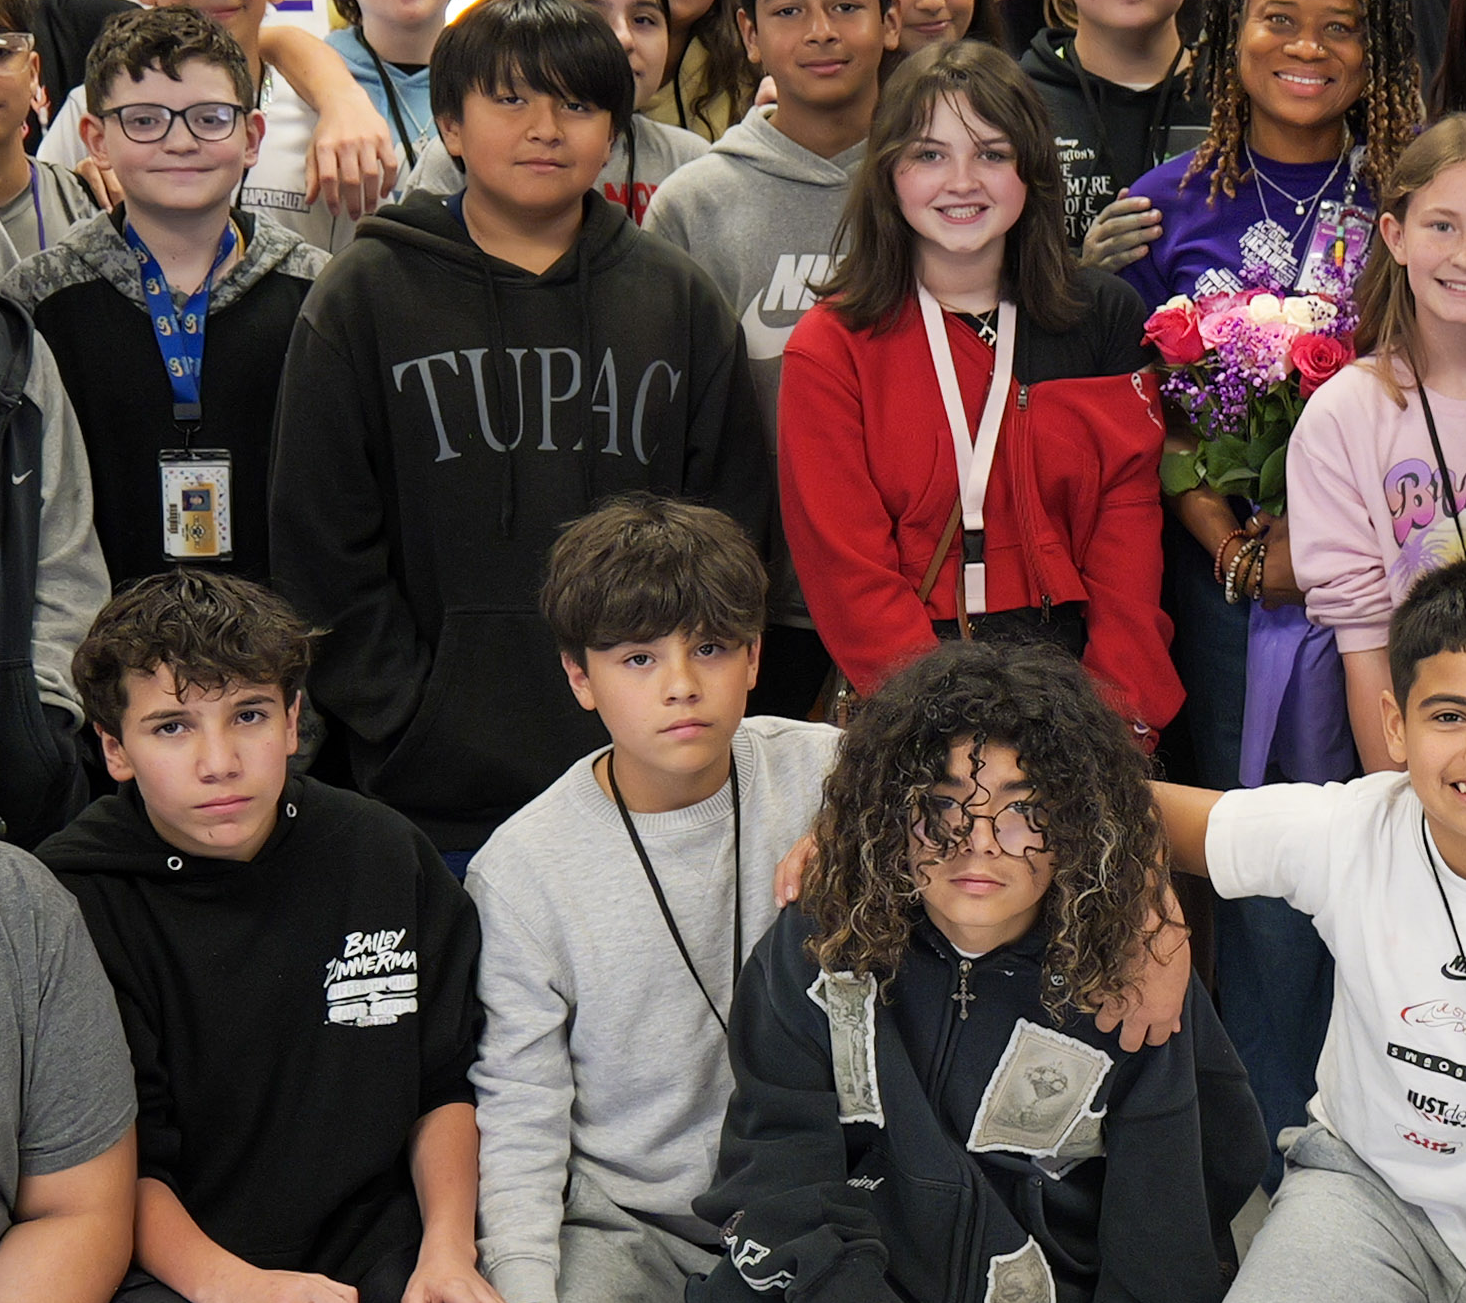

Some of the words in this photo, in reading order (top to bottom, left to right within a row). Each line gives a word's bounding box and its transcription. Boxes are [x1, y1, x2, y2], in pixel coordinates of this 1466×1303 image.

[392, 347, 683, 466] TUPAC
[344, 928, 407, 958] BAILEY
[323, 950, 418, 989] ZIMMERMA
